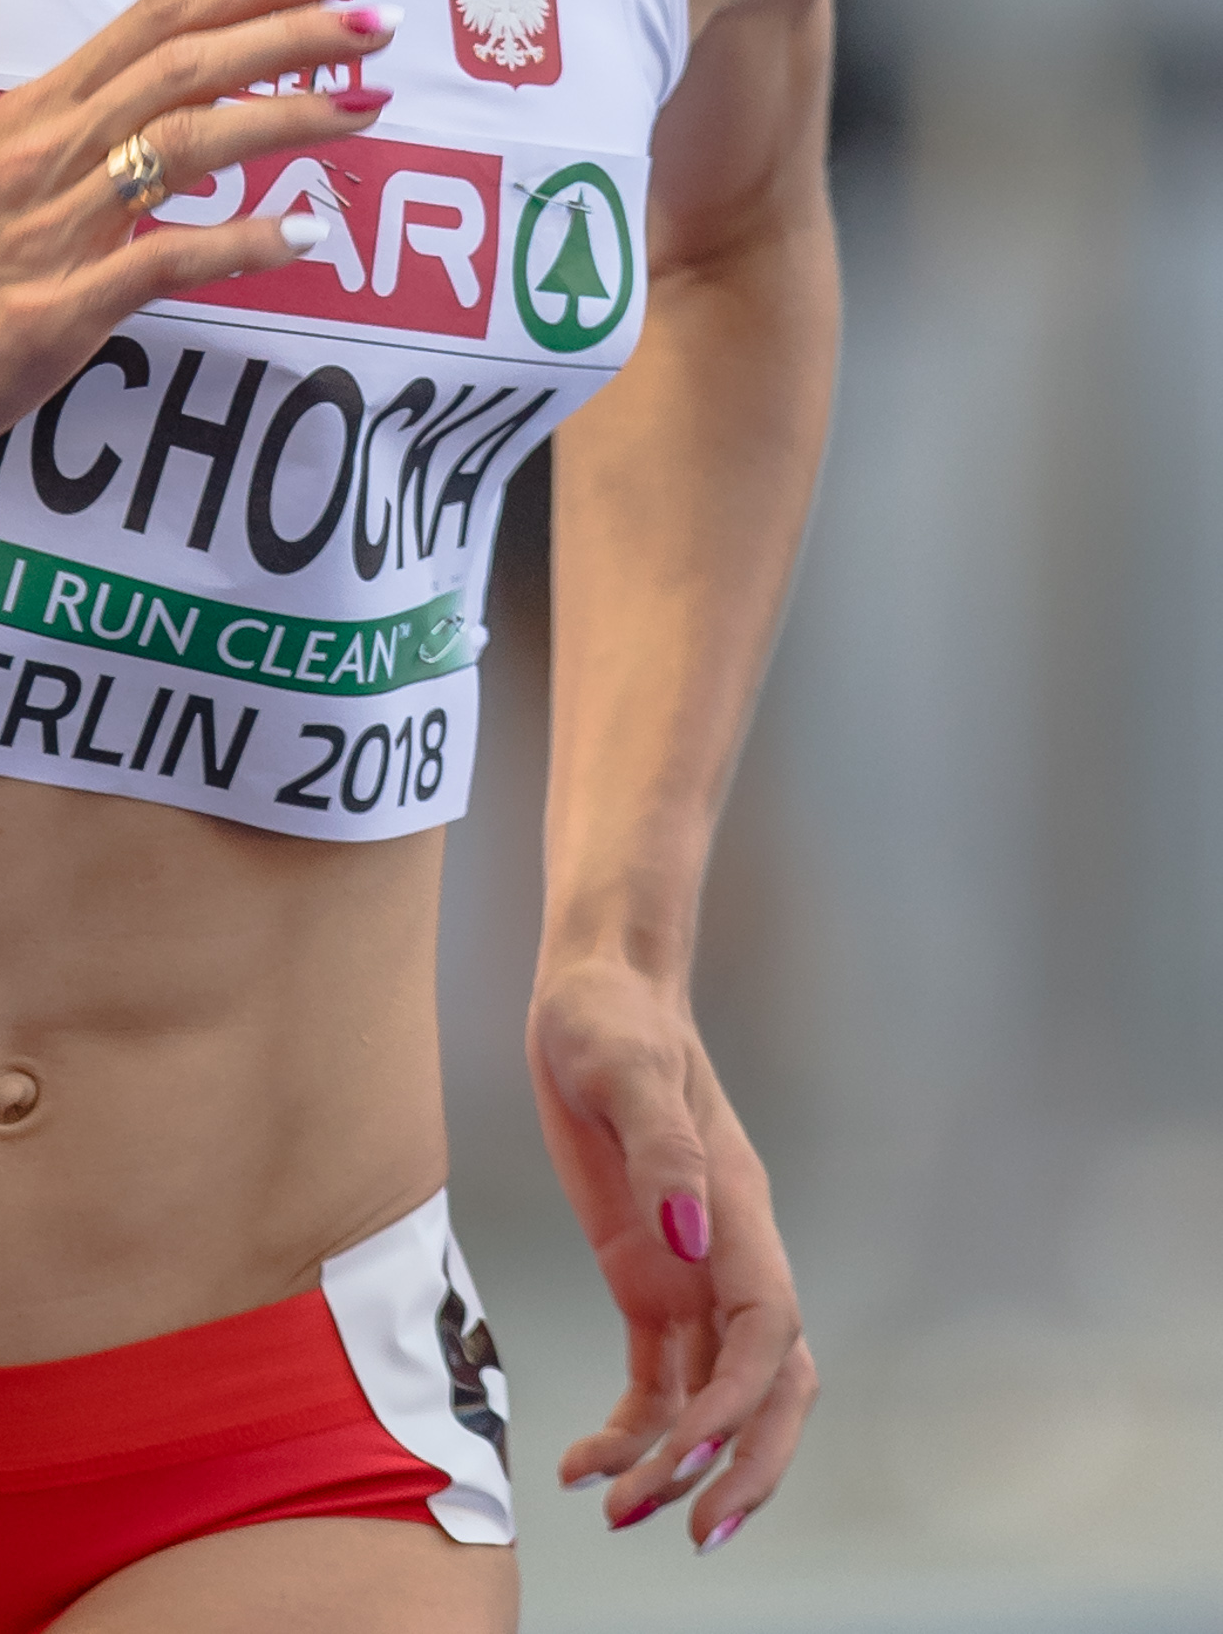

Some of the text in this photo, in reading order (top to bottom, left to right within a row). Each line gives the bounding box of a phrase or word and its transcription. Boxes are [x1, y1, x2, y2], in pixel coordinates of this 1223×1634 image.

[1, 558, 27, 613] I
[42, 569, 201, 657] RUN
[273, 707, 448, 814] 2018
